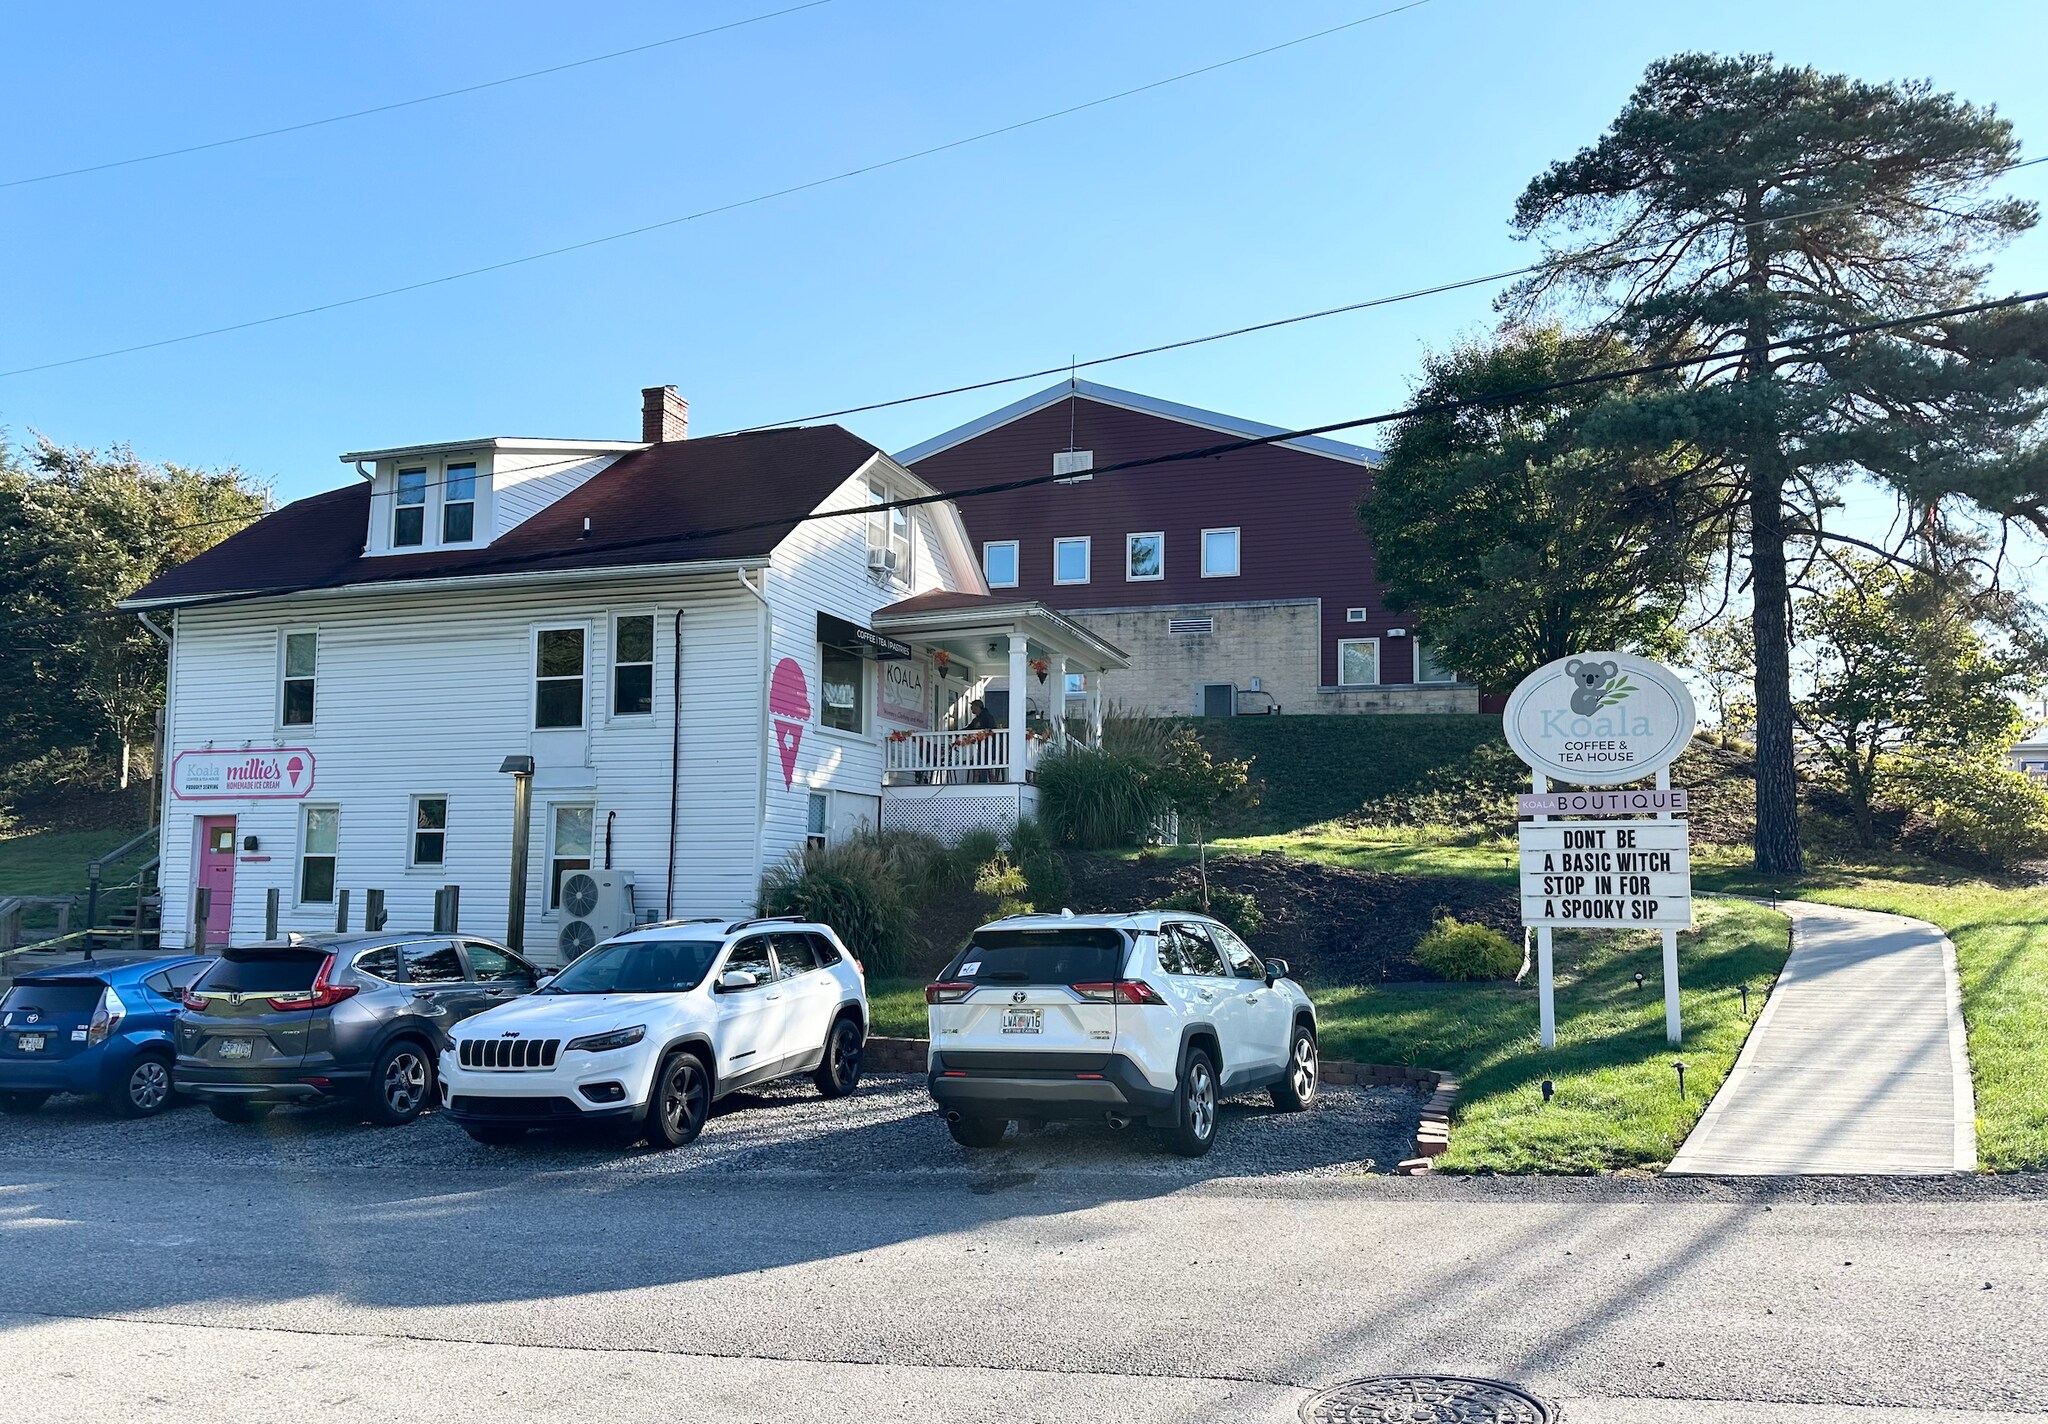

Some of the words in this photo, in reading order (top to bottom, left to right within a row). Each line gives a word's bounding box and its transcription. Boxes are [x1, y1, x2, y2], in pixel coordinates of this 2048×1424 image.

[857, 629, 876, 644] COFFEE
[878, 637, 887, 647] TEA
[890, 641, 910, 656] PASTRIES
[887, 663, 922, 690] KOALA
[1540, 706, 1654, 738] Koala
[1564, 740, 1616, 751] COFFEE
[1619, 740, 1628, 750] &
[1558, 752, 1584, 763] TEA
[1587, 751, 1634, 762] HOUSE
[187, 763, 220, 777] Koala
[226, 758, 282, 780] millie's
[226, 781, 254, 790] HOMEMADE
[254, 781, 262, 790] ICE
[263, 780, 280, 790] CREAM
[1522, 799, 1556, 810] KOALA
[1558, 792, 1682, 811] BOUTIQUE
[1563, 829, 1606, 849] DONT
[1616, 829, 1636, 848] BE
[1544, 853, 1554, 872] A
[1562, 852, 1611, 873] BASIC
[1617, 852, 1671, 872] WITCH
[1543, 876, 1585, 896] STOP
[1595, 876, 1612, 895] IN
[1620, 876, 1651, 896] FOR
[1544, 899, 1555, 919] A
[1562, 899, 1625, 919] SPOOKY
[1631, 899, 1659, 919] SIP
